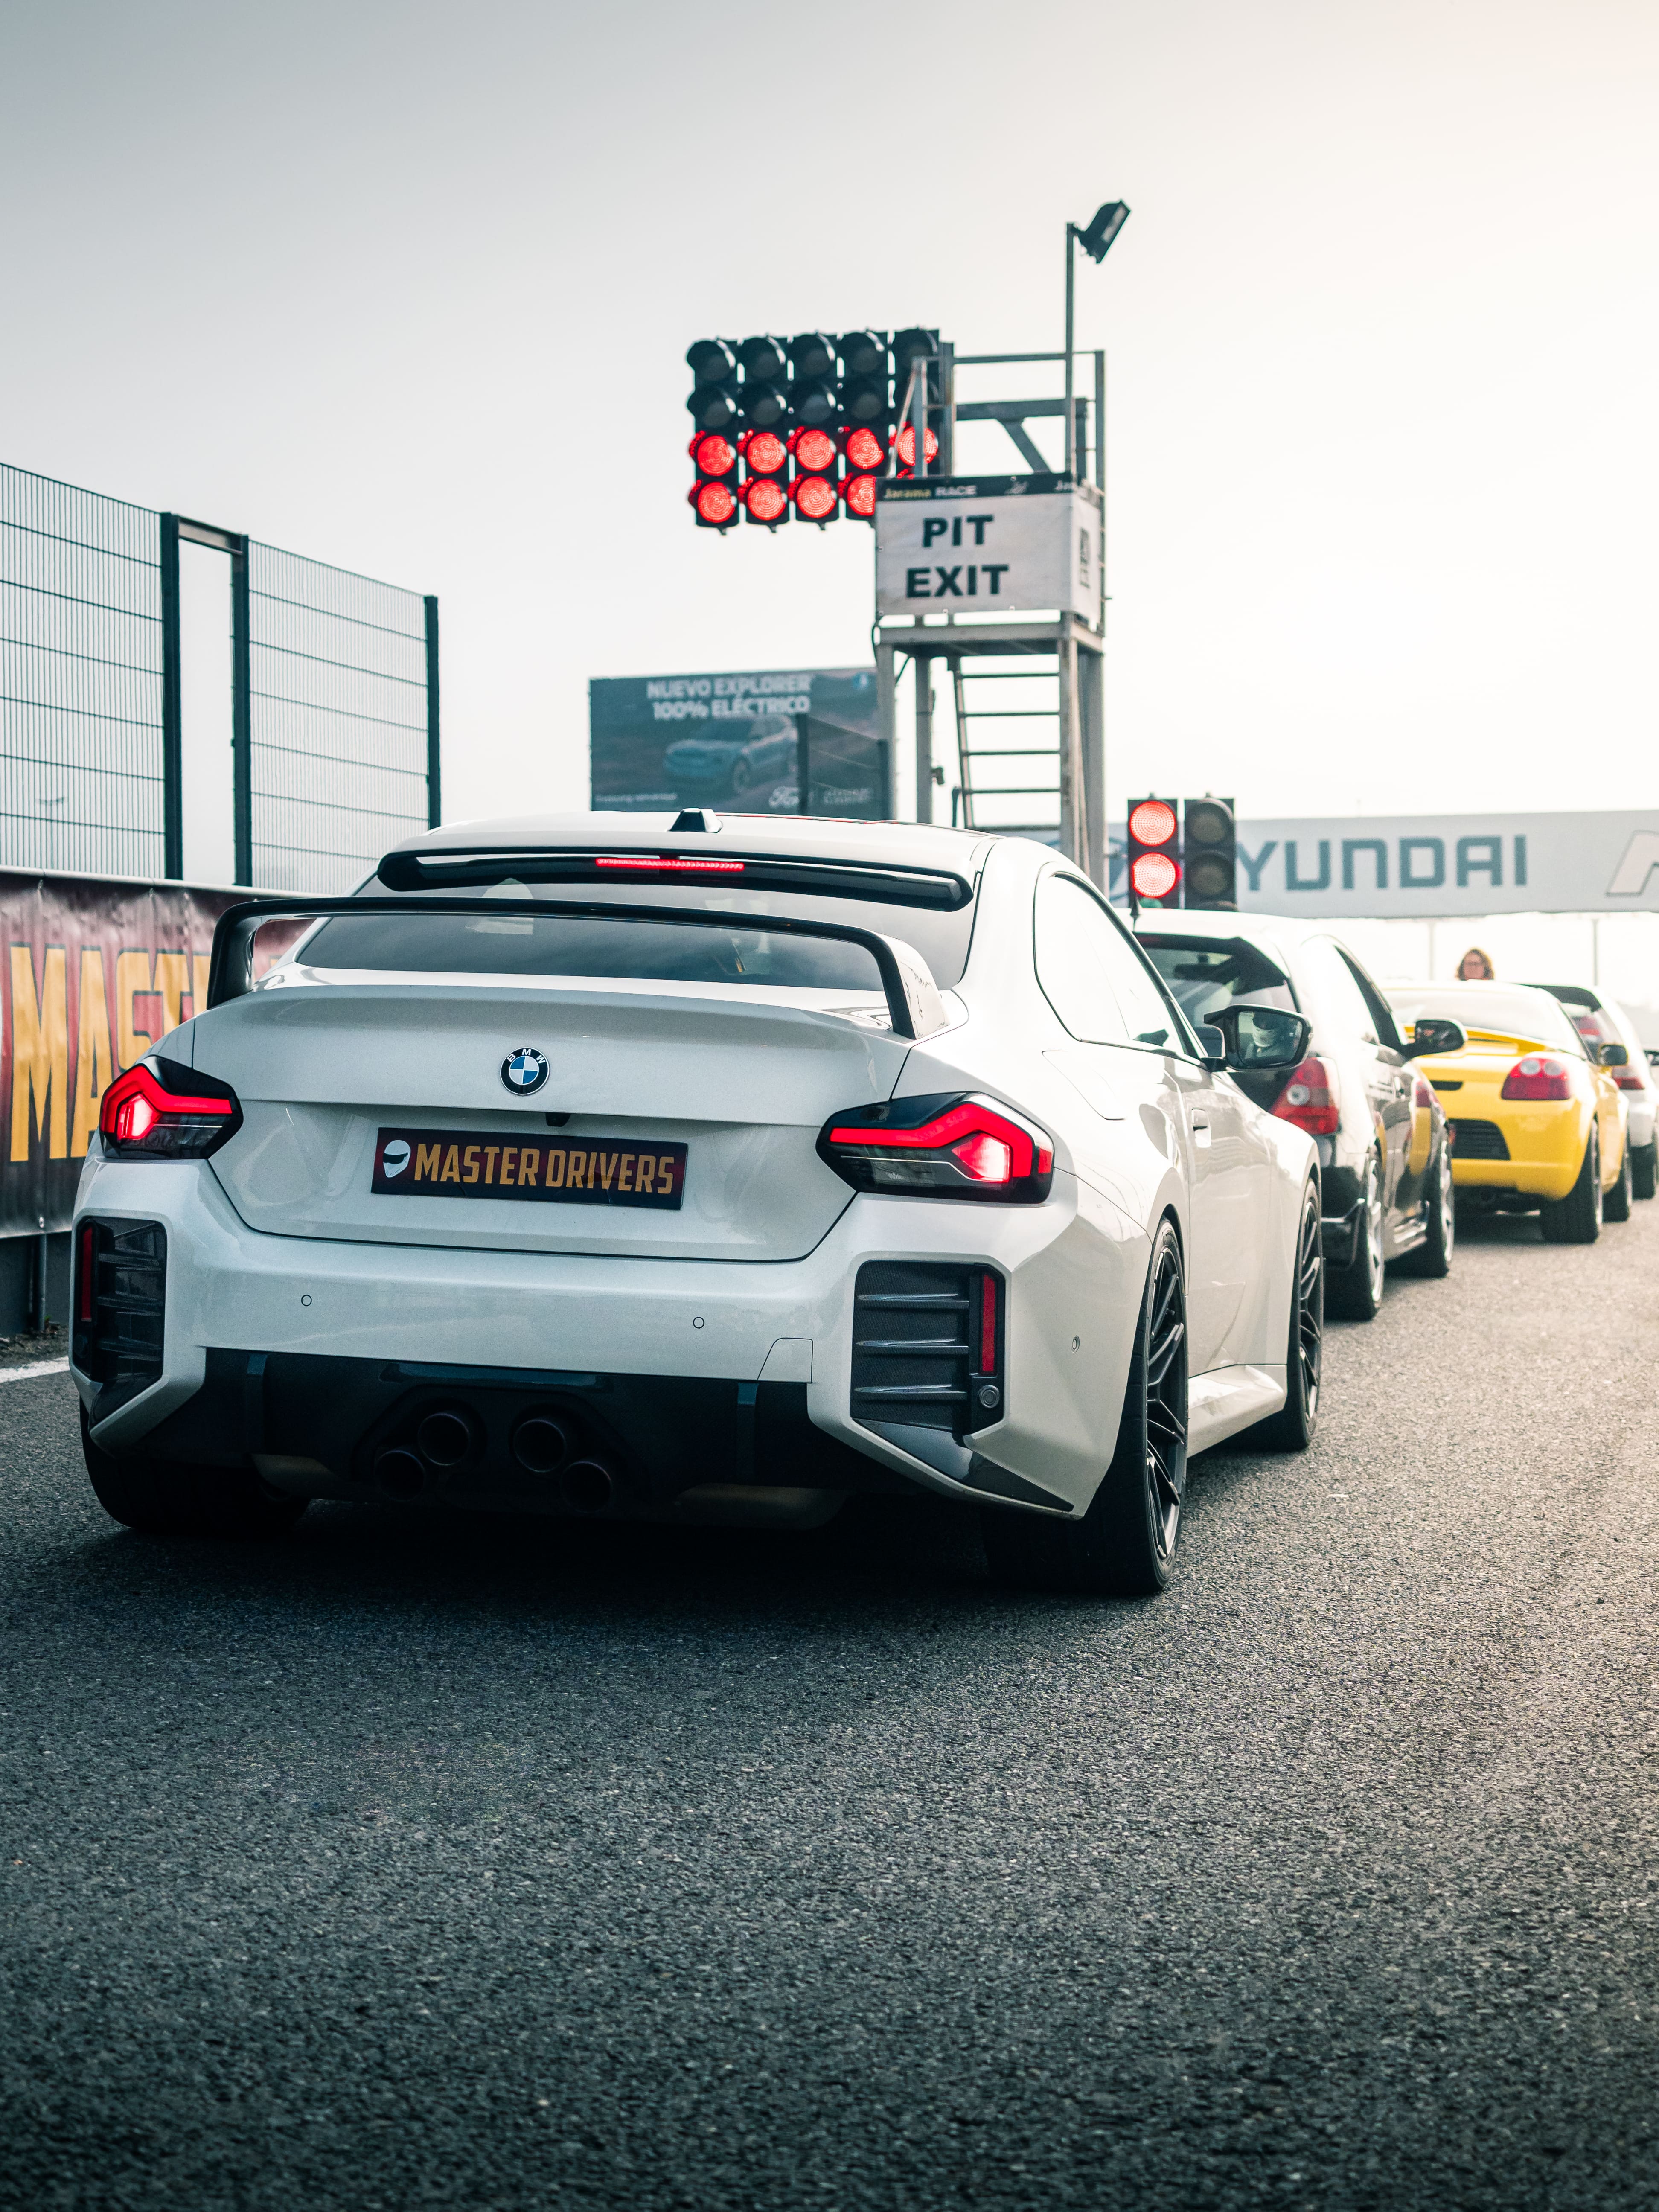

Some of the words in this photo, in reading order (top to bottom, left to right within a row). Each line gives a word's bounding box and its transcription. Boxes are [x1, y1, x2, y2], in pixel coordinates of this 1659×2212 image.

[935, 485, 977, 496] RACE
[922, 514, 995, 548] PIT
[906, 563, 1010, 599] EXIT
[646, 679, 711, 699] NUEVO
[713, 674, 810, 697] EXPLORER
[653, 700, 709, 720] 100%
[1236, 835, 1527, 891] YUNDAI
[507, 1048, 546, 1064] BMW
[414, 1144, 540, 1186] MASTER
[545, 1150, 675, 1194] DRIVERS
